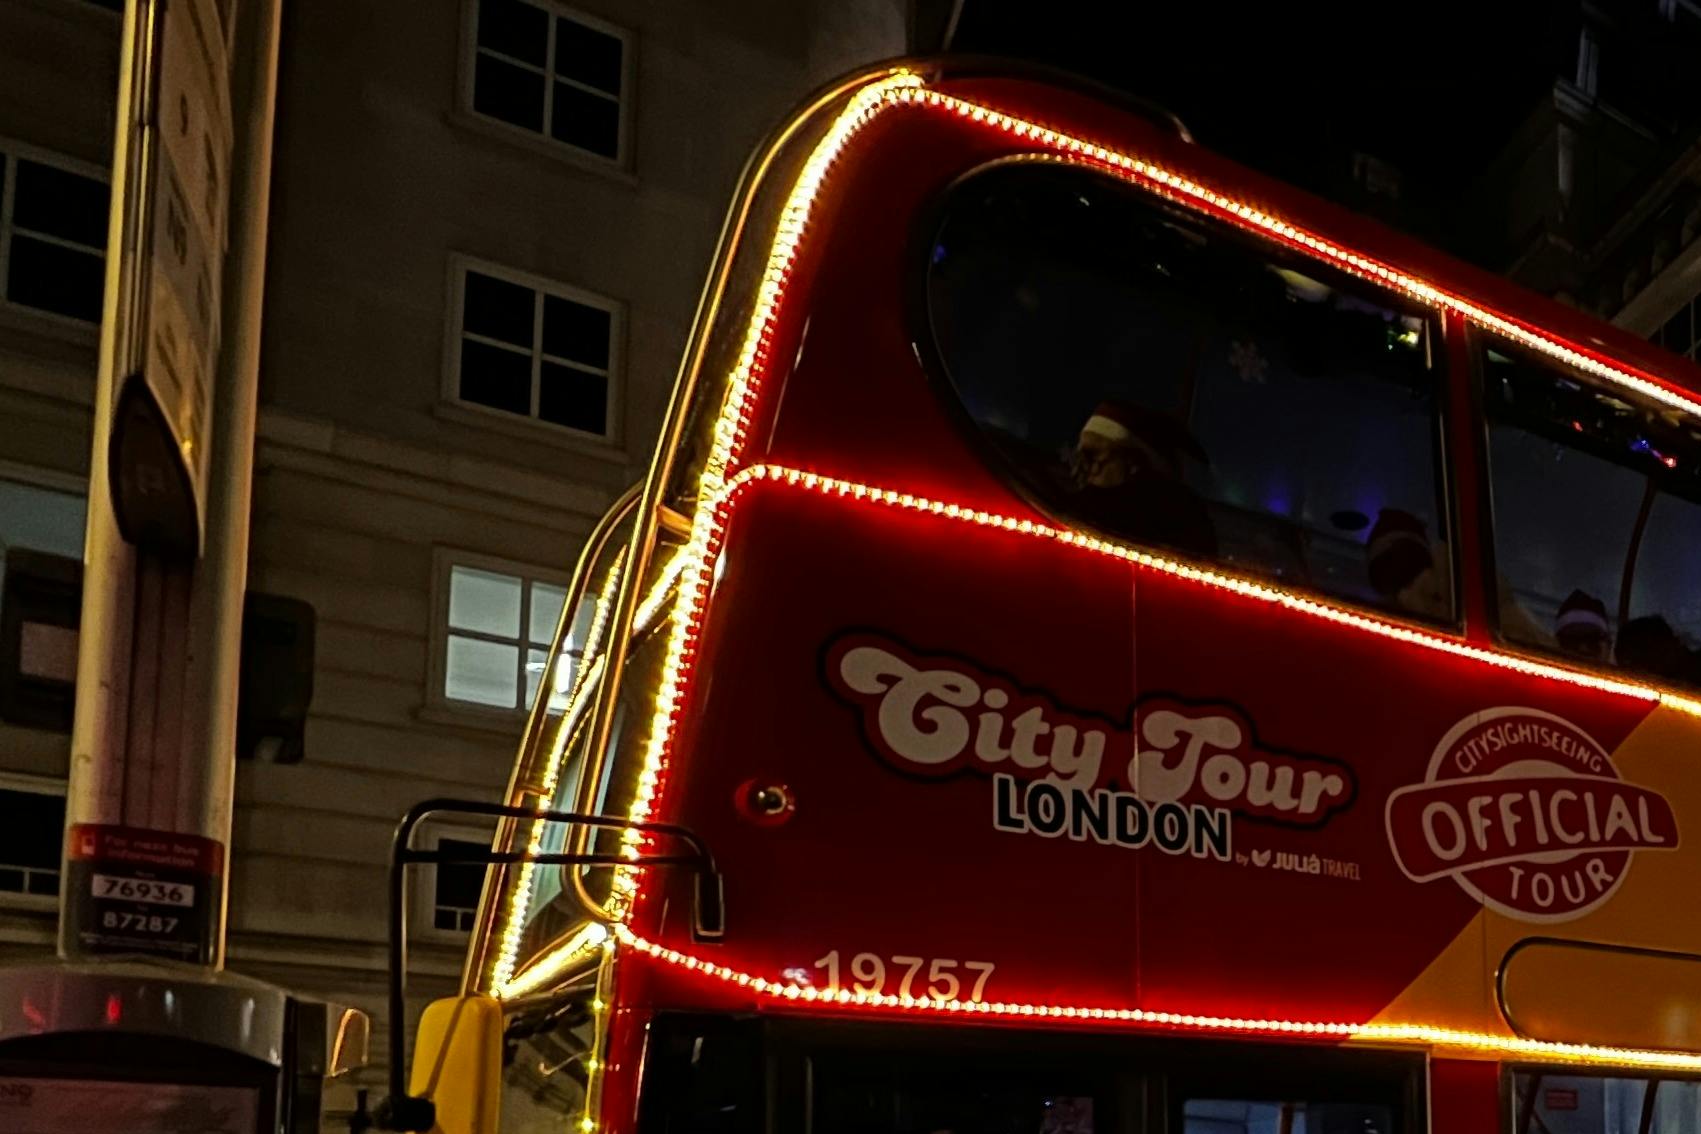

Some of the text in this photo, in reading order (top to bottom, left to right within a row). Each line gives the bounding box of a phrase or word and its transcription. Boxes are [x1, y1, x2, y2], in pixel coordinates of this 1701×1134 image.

[840, 646, 1345, 815] City Tour
[1455, 722, 1604, 774] CITYSIGHTSEEING
[993, 772, 1231, 861] LONDON
[1421, 788, 1666, 862] OFFICIAL
[103, 879, 183, 903] 76936
[1508, 857, 1615, 908] TOUR
[103, 911, 179, 934] 87287
[814, 949, 996, 1005] 19757
